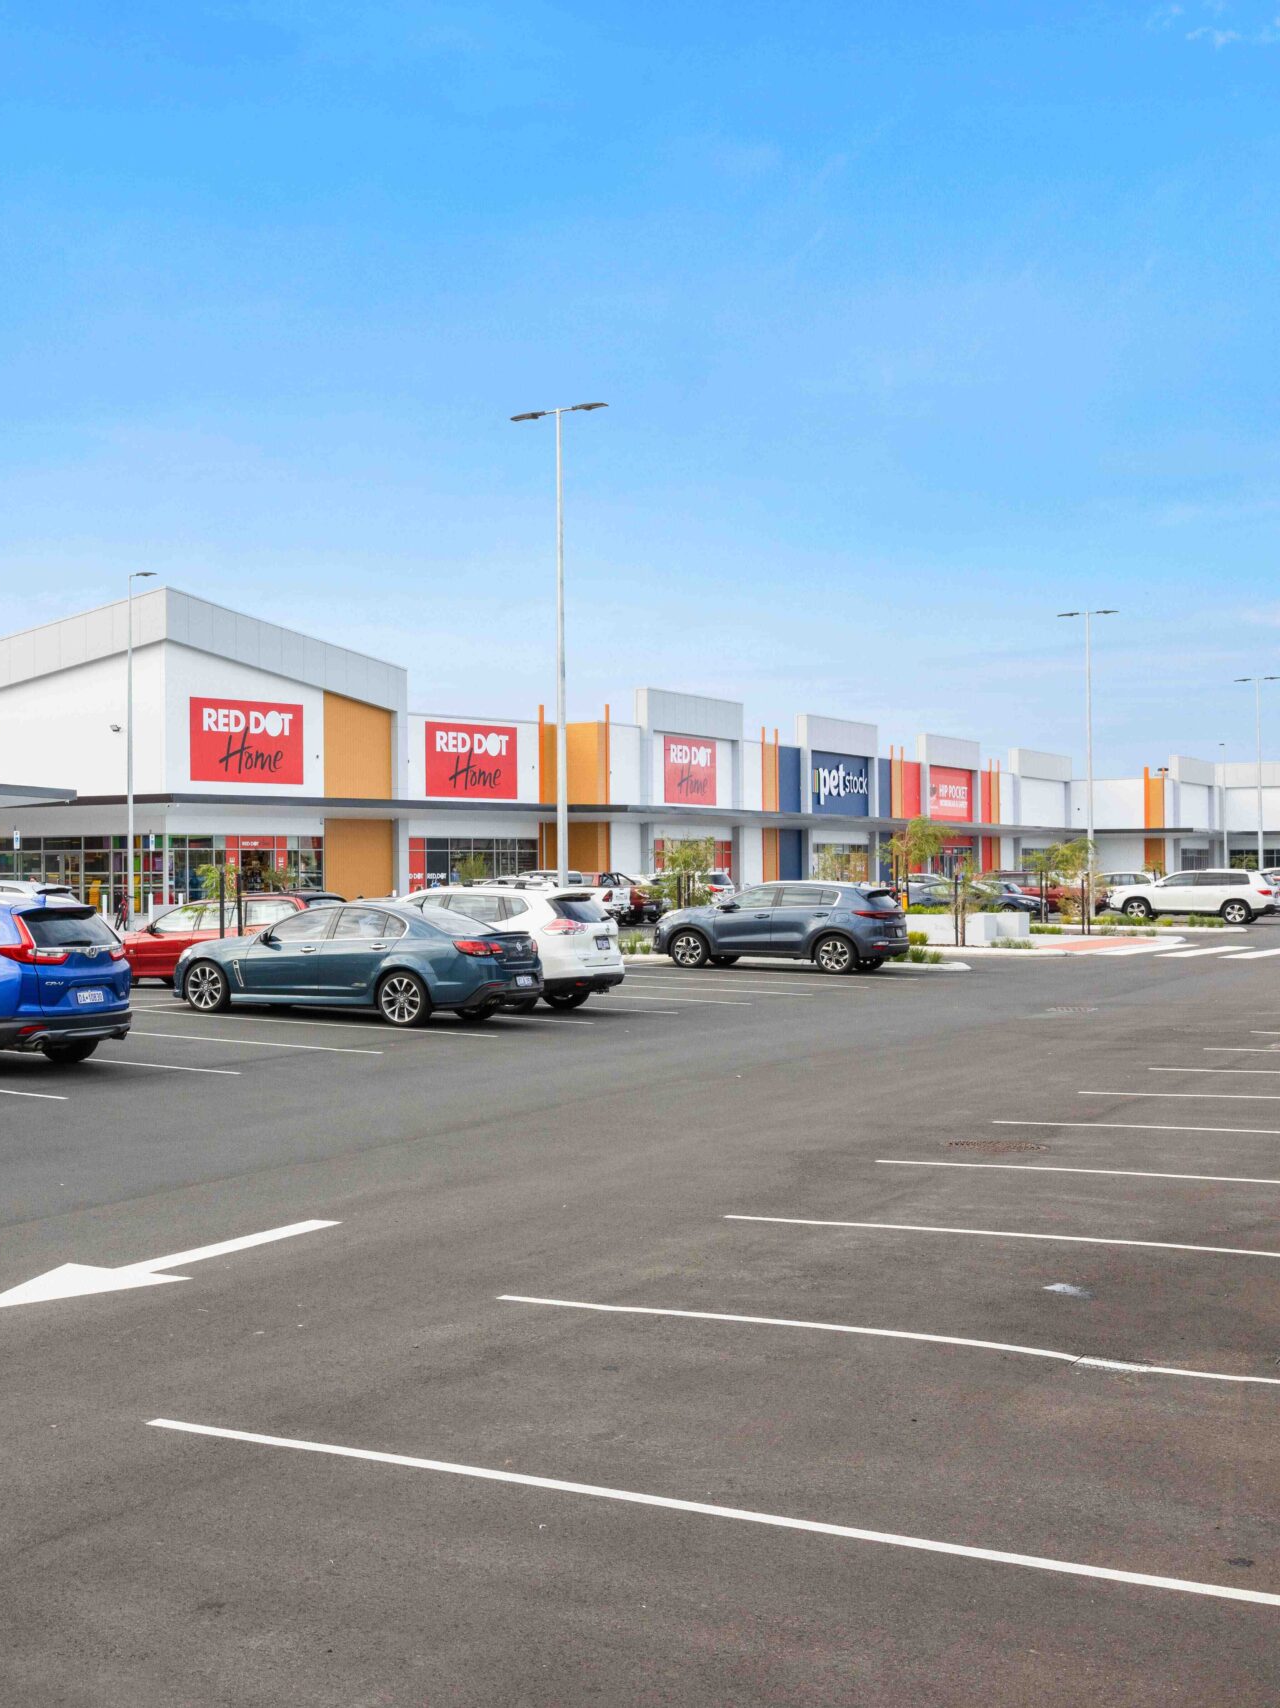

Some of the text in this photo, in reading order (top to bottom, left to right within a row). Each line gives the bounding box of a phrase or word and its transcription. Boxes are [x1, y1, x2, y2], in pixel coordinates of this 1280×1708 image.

[203, 707, 293, 737] RED DOT
[219, 726, 283, 774] Home
[435, 731, 509, 757] RED DOT
[670, 743, 712, 768] RED DOT
[448, 747, 502, 790] Home
[677, 760, 708, 797] Home
[939, 784, 968, 799] HIP POCKET
